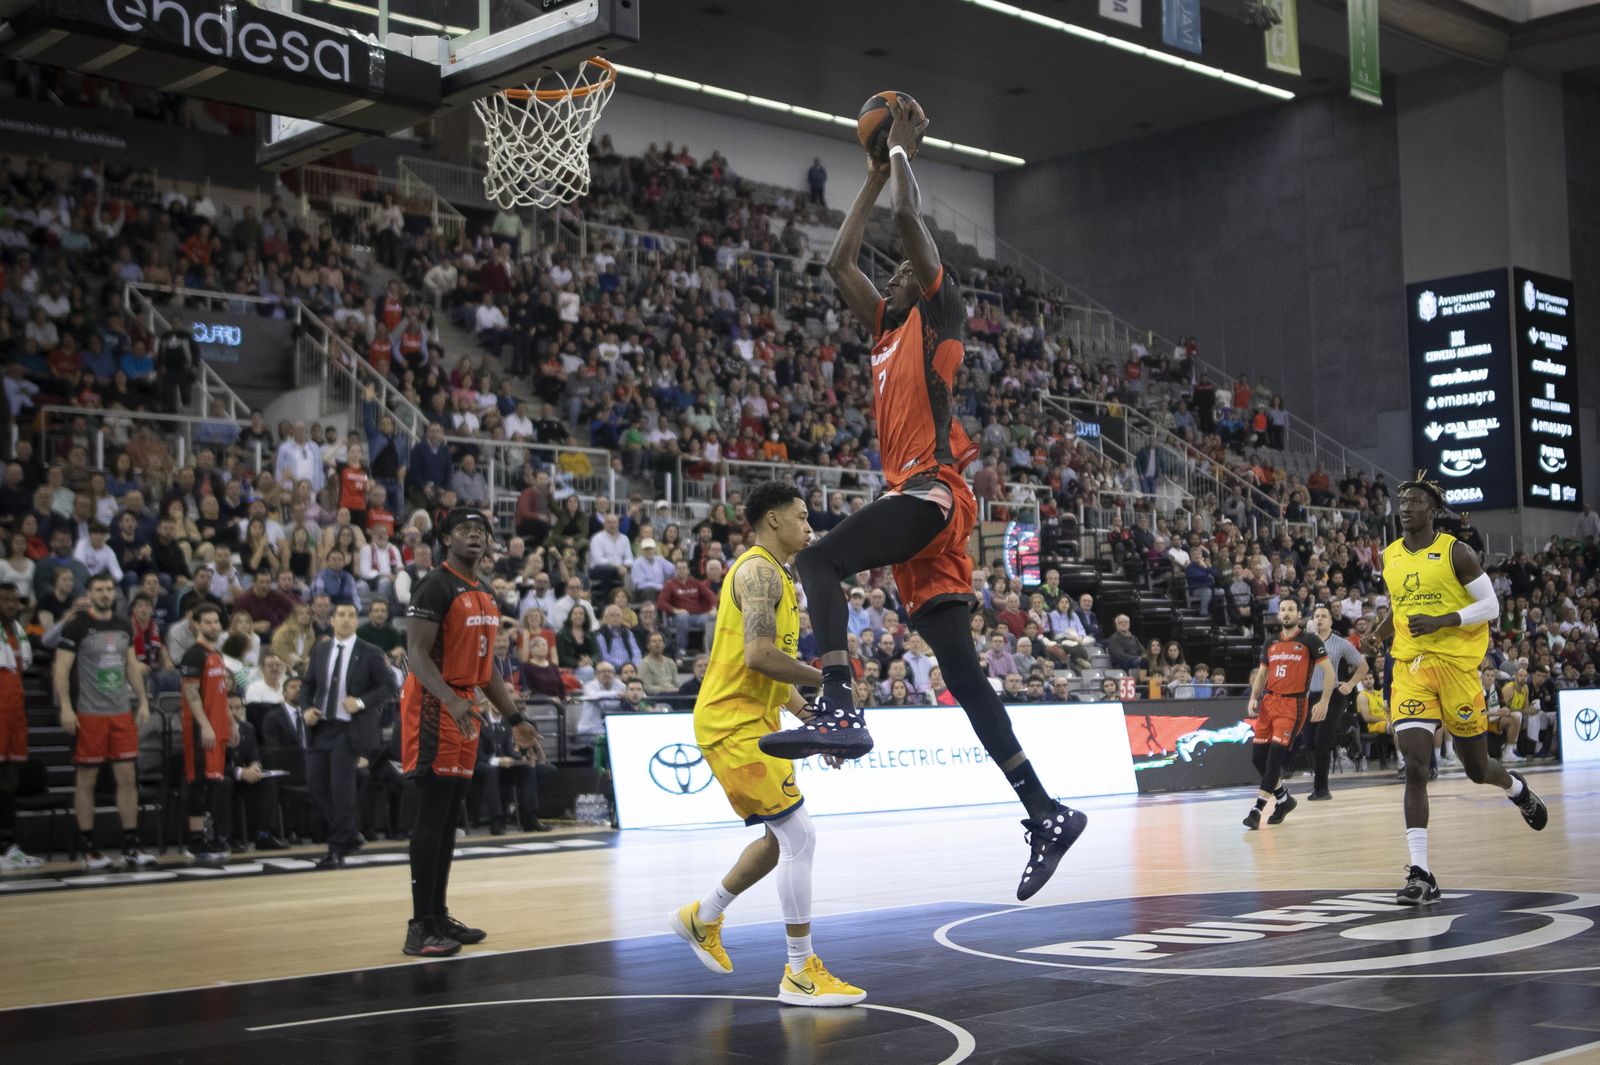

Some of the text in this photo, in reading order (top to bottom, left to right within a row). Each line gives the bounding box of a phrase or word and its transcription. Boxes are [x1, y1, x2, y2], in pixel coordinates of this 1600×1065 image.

[106, 0, 350, 82] endesa
[1438, 289, 1496, 306] AYUNTAMIENTO
[1442, 301, 1491, 316] DE GRANADA
[1425, 349, 1457, 363] CERVEZAS
[878, 368, 887, 397] 7
[1437, 390, 1496, 408] emasagra
[1442, 447, 1483, 463] PULEVA
[478, 634, 489, 657] 3
[1275, 664, 1288, 679] 15
[1120, 679, 1135, 699] 55
[868, 748, 947, 769] ELECTRIC
